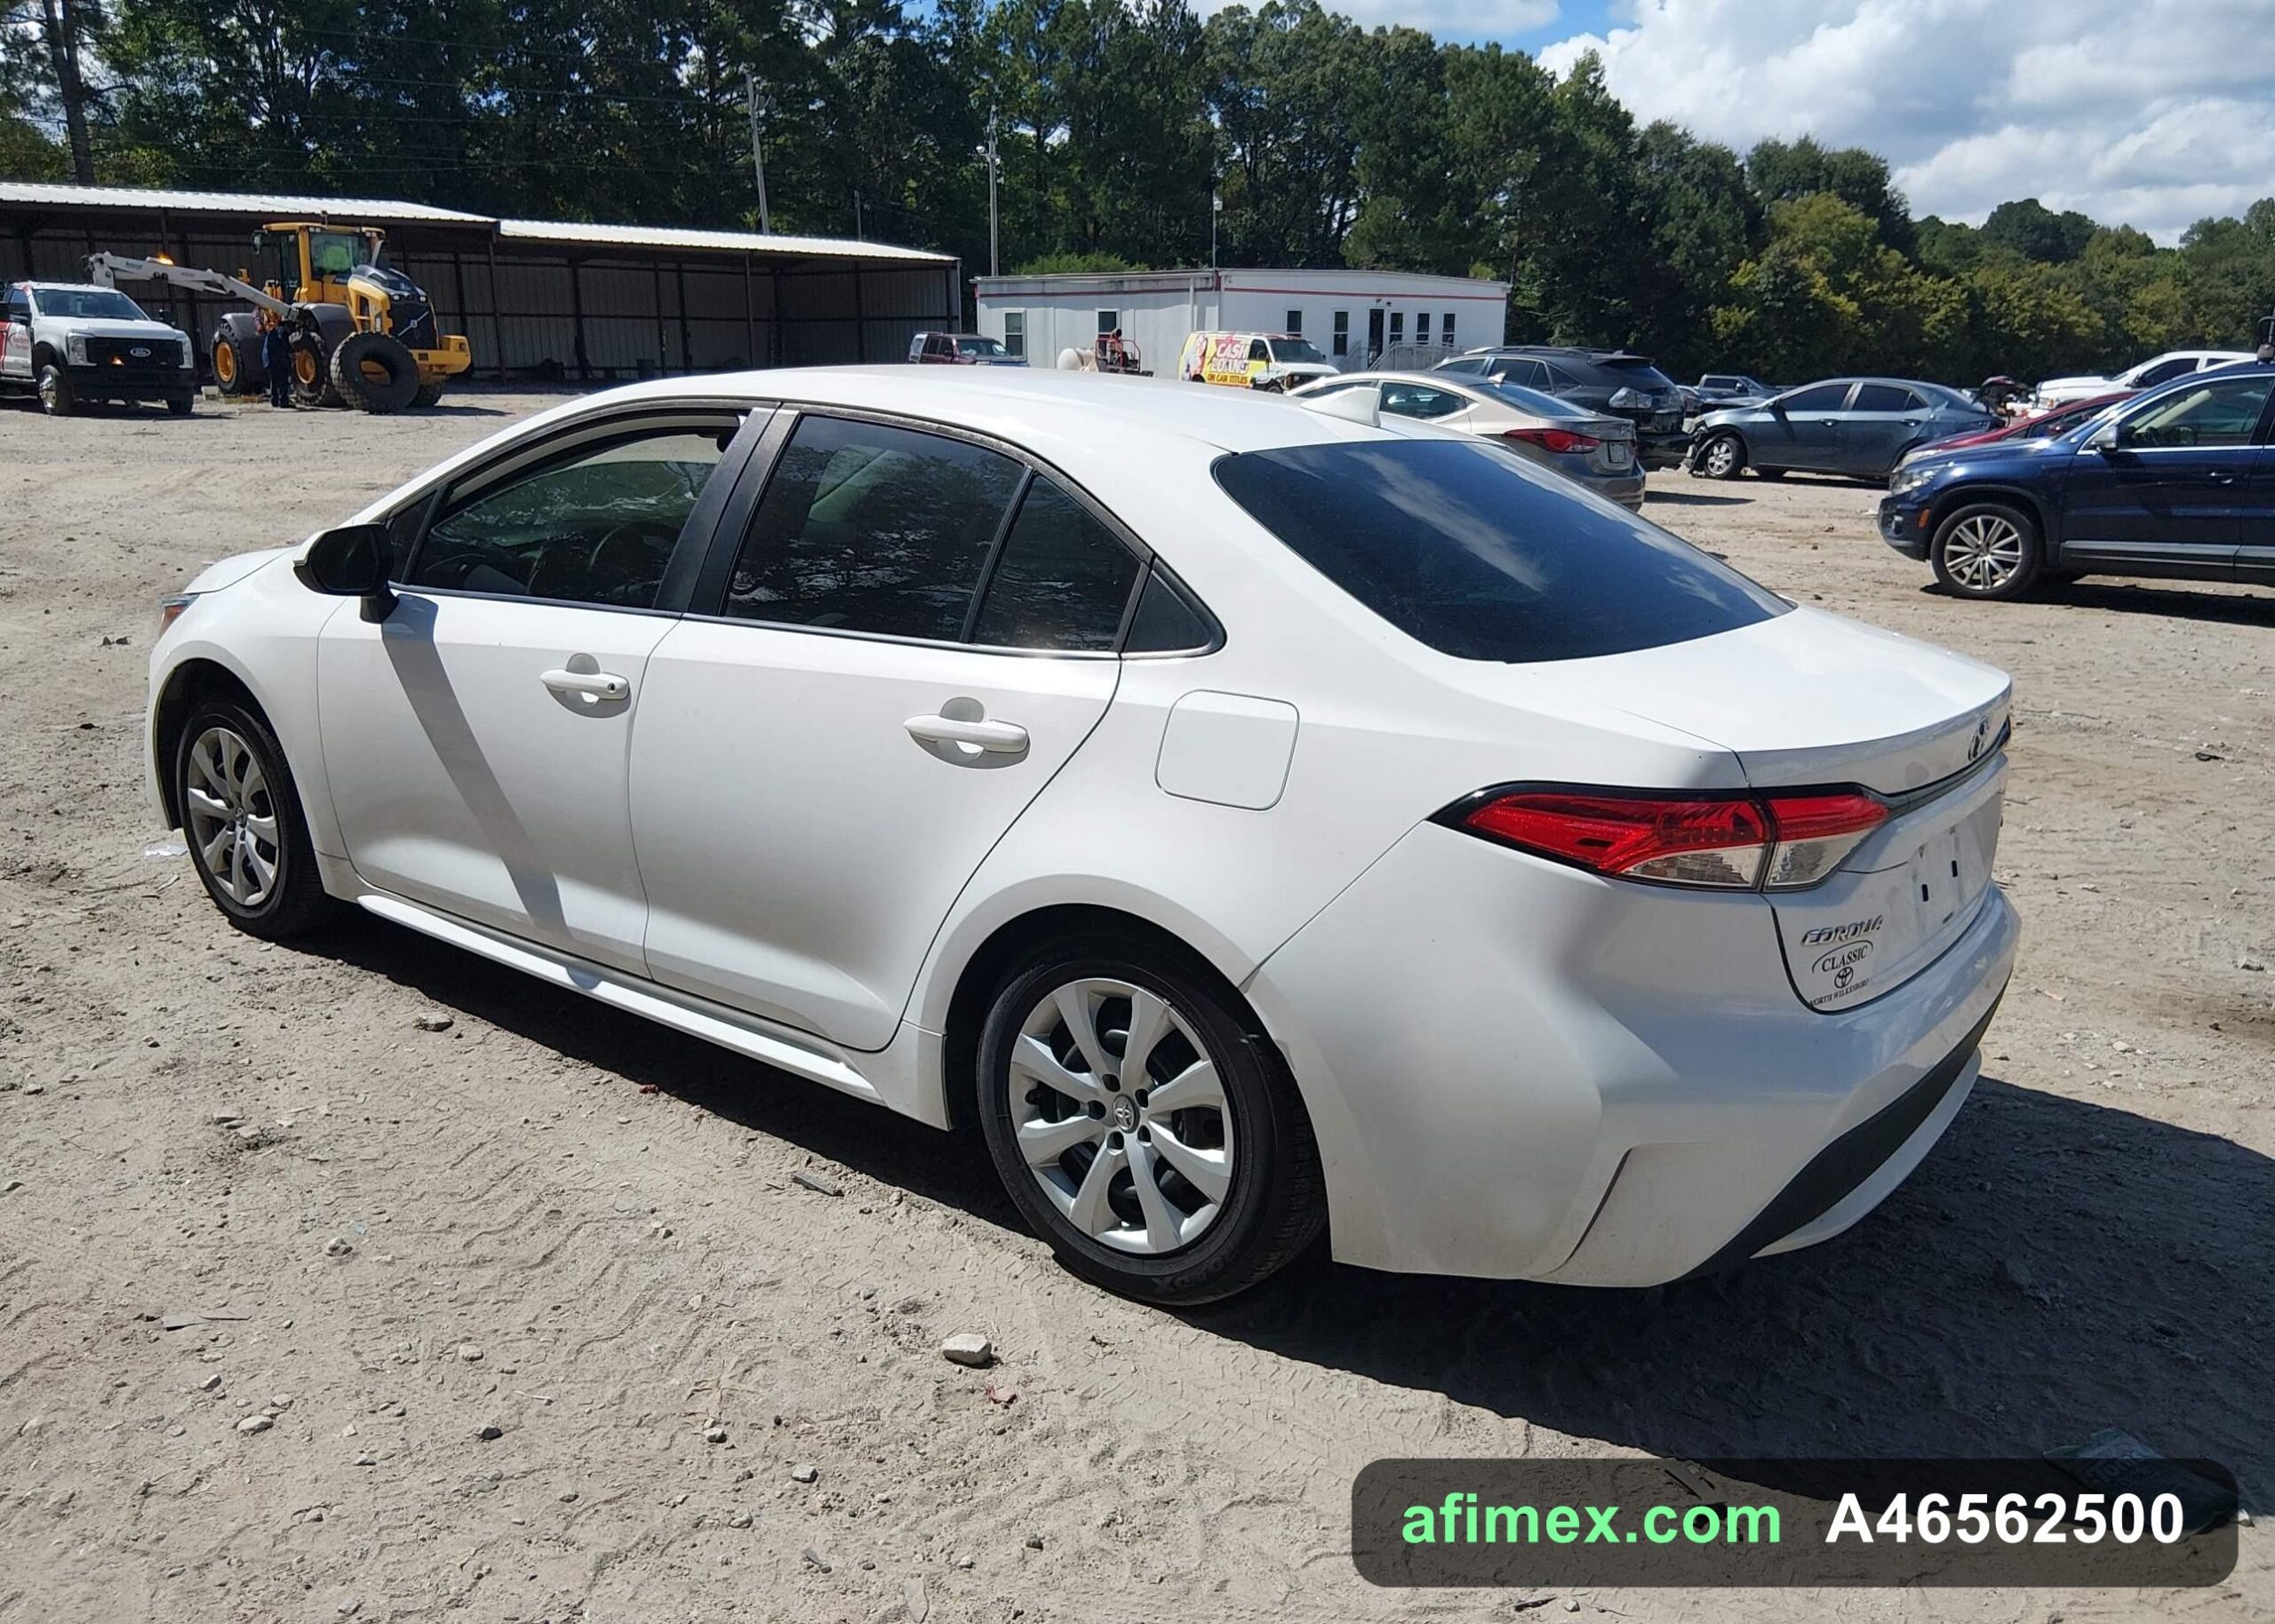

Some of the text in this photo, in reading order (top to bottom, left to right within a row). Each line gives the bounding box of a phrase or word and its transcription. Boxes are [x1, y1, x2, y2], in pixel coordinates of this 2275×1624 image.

[1217, 343, 1249, 360] CASH
[1209, 357, 1249, 374] LOANS
[1821, 945, 1868, 972] CLASSIC
[1809, 994, 1832, 1007] NORTH
